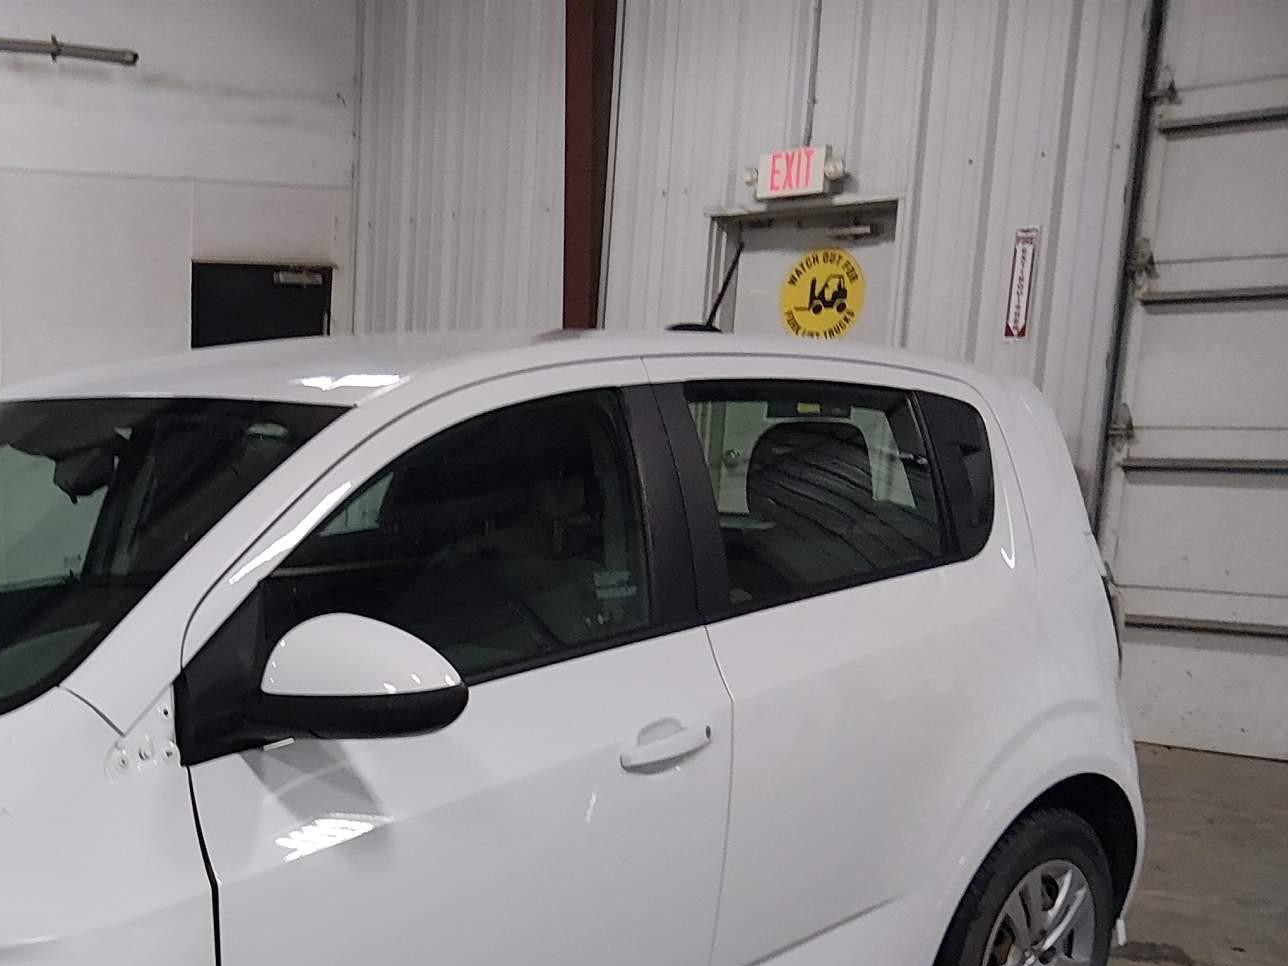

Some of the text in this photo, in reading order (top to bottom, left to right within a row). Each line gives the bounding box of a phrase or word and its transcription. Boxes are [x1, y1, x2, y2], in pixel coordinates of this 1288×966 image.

[769, 149, 815, 192] EXIT
[787, 253, 820, 286] WATCH
[822, 251, 843, 267] OUT
[822, 309, 856, 340] TRUCKS
